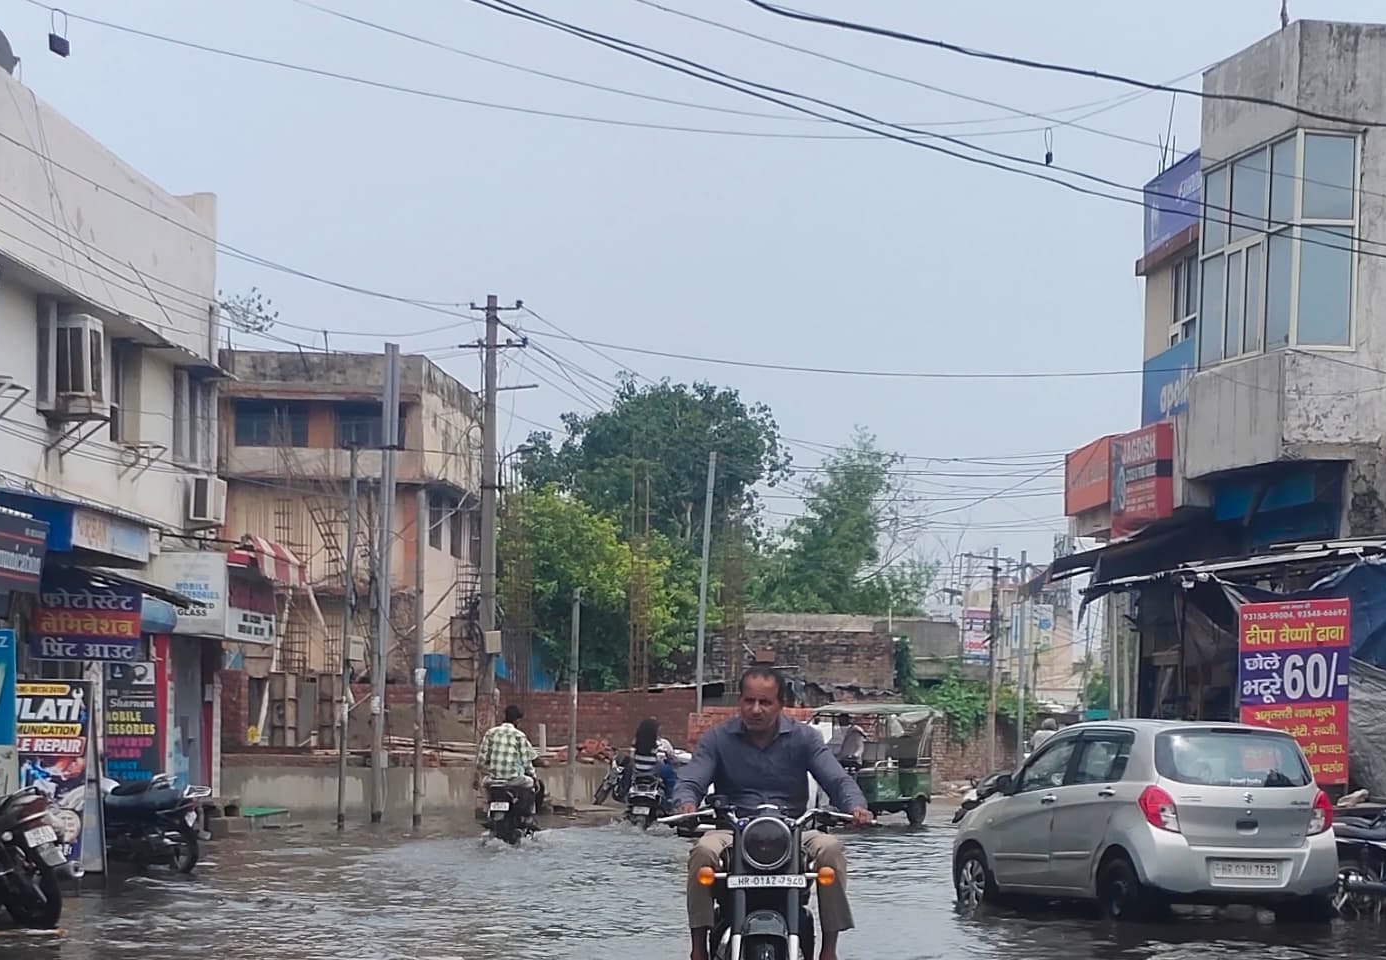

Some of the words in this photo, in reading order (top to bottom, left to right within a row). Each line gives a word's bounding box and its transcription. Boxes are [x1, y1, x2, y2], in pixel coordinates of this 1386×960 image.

[1159, 363, 1194, 416] apoll
[177, 609, 208, 617] GLASS
[41, 614, 133, 637] लेमिनेशन
[1245, 623, 1275, 645] दीपा
[1316, 625, 1345, 643] ढाबा
[82, 643, 134, 660] आउट
[1244, 653, 1281, 671] छोले
[1283, 652, 1348, 700] 60/-
[1243, 673, 1283, 703] भटूरे
[33, 738, 81, 753] REPAIR
